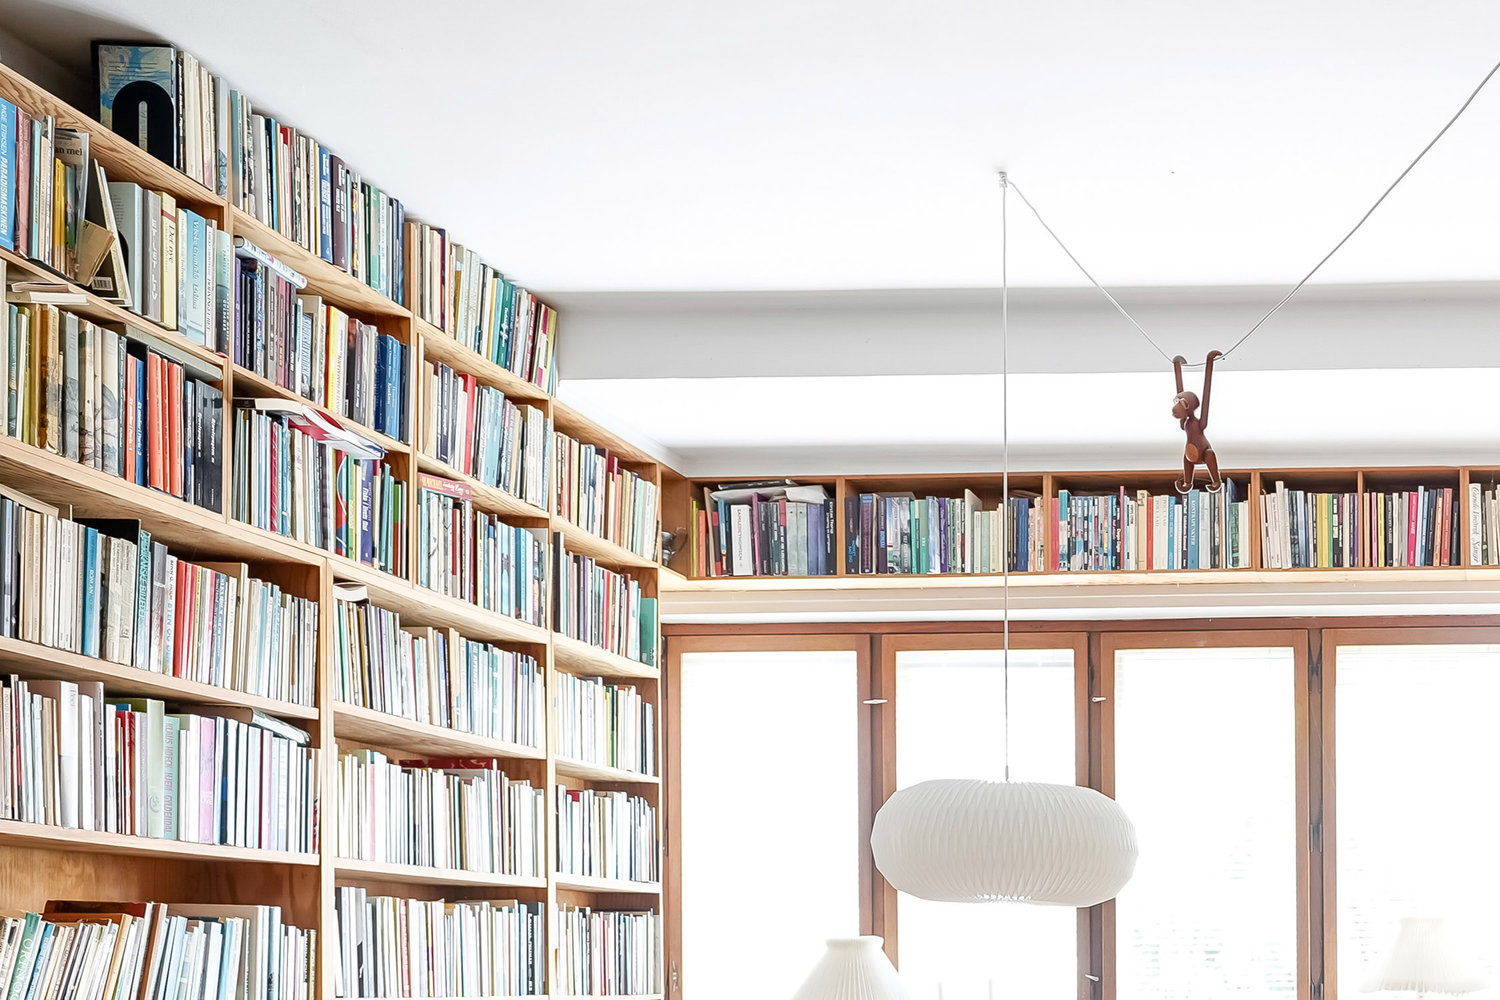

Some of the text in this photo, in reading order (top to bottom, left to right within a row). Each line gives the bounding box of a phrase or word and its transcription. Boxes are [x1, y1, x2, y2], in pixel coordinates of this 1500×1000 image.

[0, 104, 9, 235] INGE ERIKSEN PARADISMASKINEN
[192, 220, 200, 245] Vibeke
[138, 533, 149, 622] AMERIKANSKE BILLEDER
[166, 628, 173, 642] OG
[163, 723, 174, 833] KLAUS HØECK HJEM GYLDENDAL
